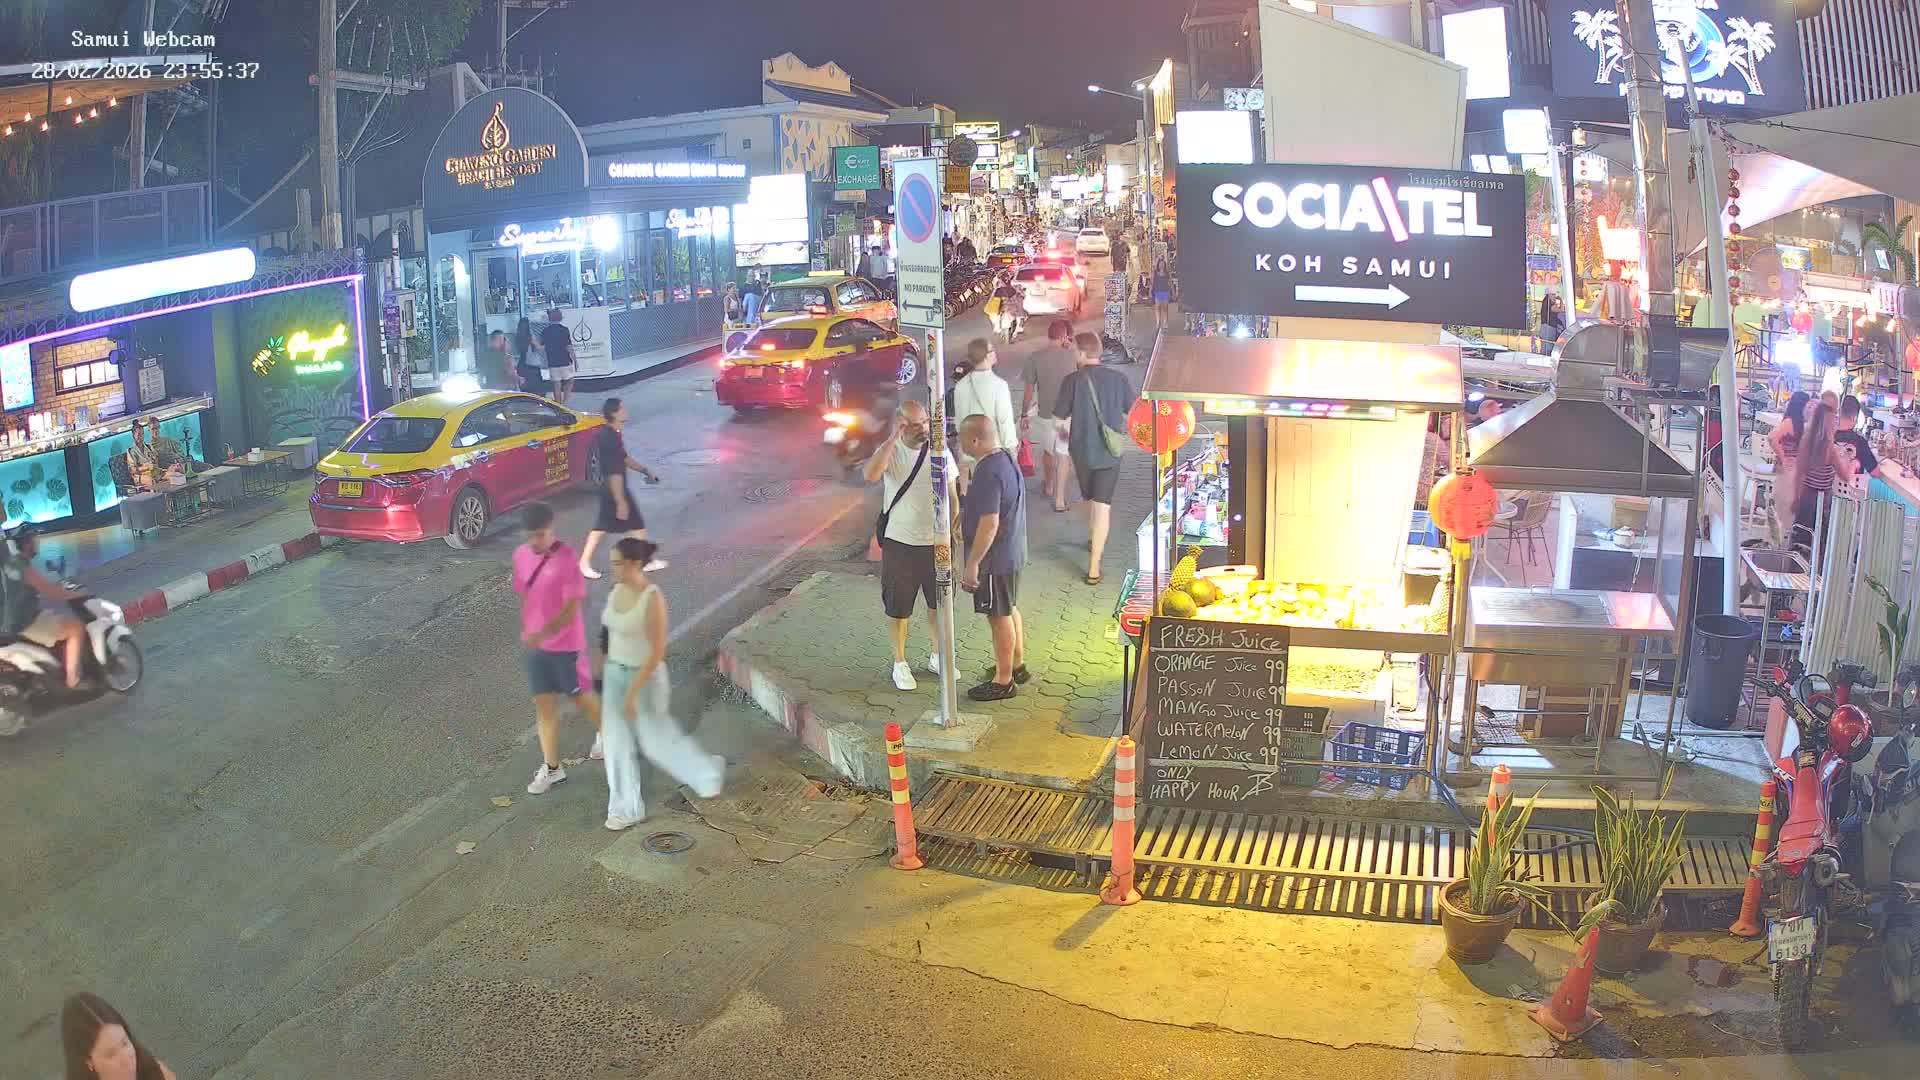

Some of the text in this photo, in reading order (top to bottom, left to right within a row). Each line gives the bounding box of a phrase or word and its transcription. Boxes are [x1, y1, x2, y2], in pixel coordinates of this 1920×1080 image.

[837, 175, 877, 184] EXCHANGE
[1255, 254, 1451, 279] KOH SAMUI
[904, 283, 936, 294] NO PARKING
[1160, 624, 1283, 651] FRESH Juice
[1154, 652, 1285, 684] ORANGE Juice 99
[1268, 685, 1286, 705] 99
[1216, 703, 1261, 720] Juice
[1264, 708, 1283, 727] 99
[1262, 726, 1281, 746] 99
[1222, 746, 1253, 761] Juice
[1259, 746, 1279, 767] 99
[1150, 781, 1201, 802] HAPPY
[1208, 783, 1240, 802] HOUR
[1776, 943, 1807, 960] 6133
